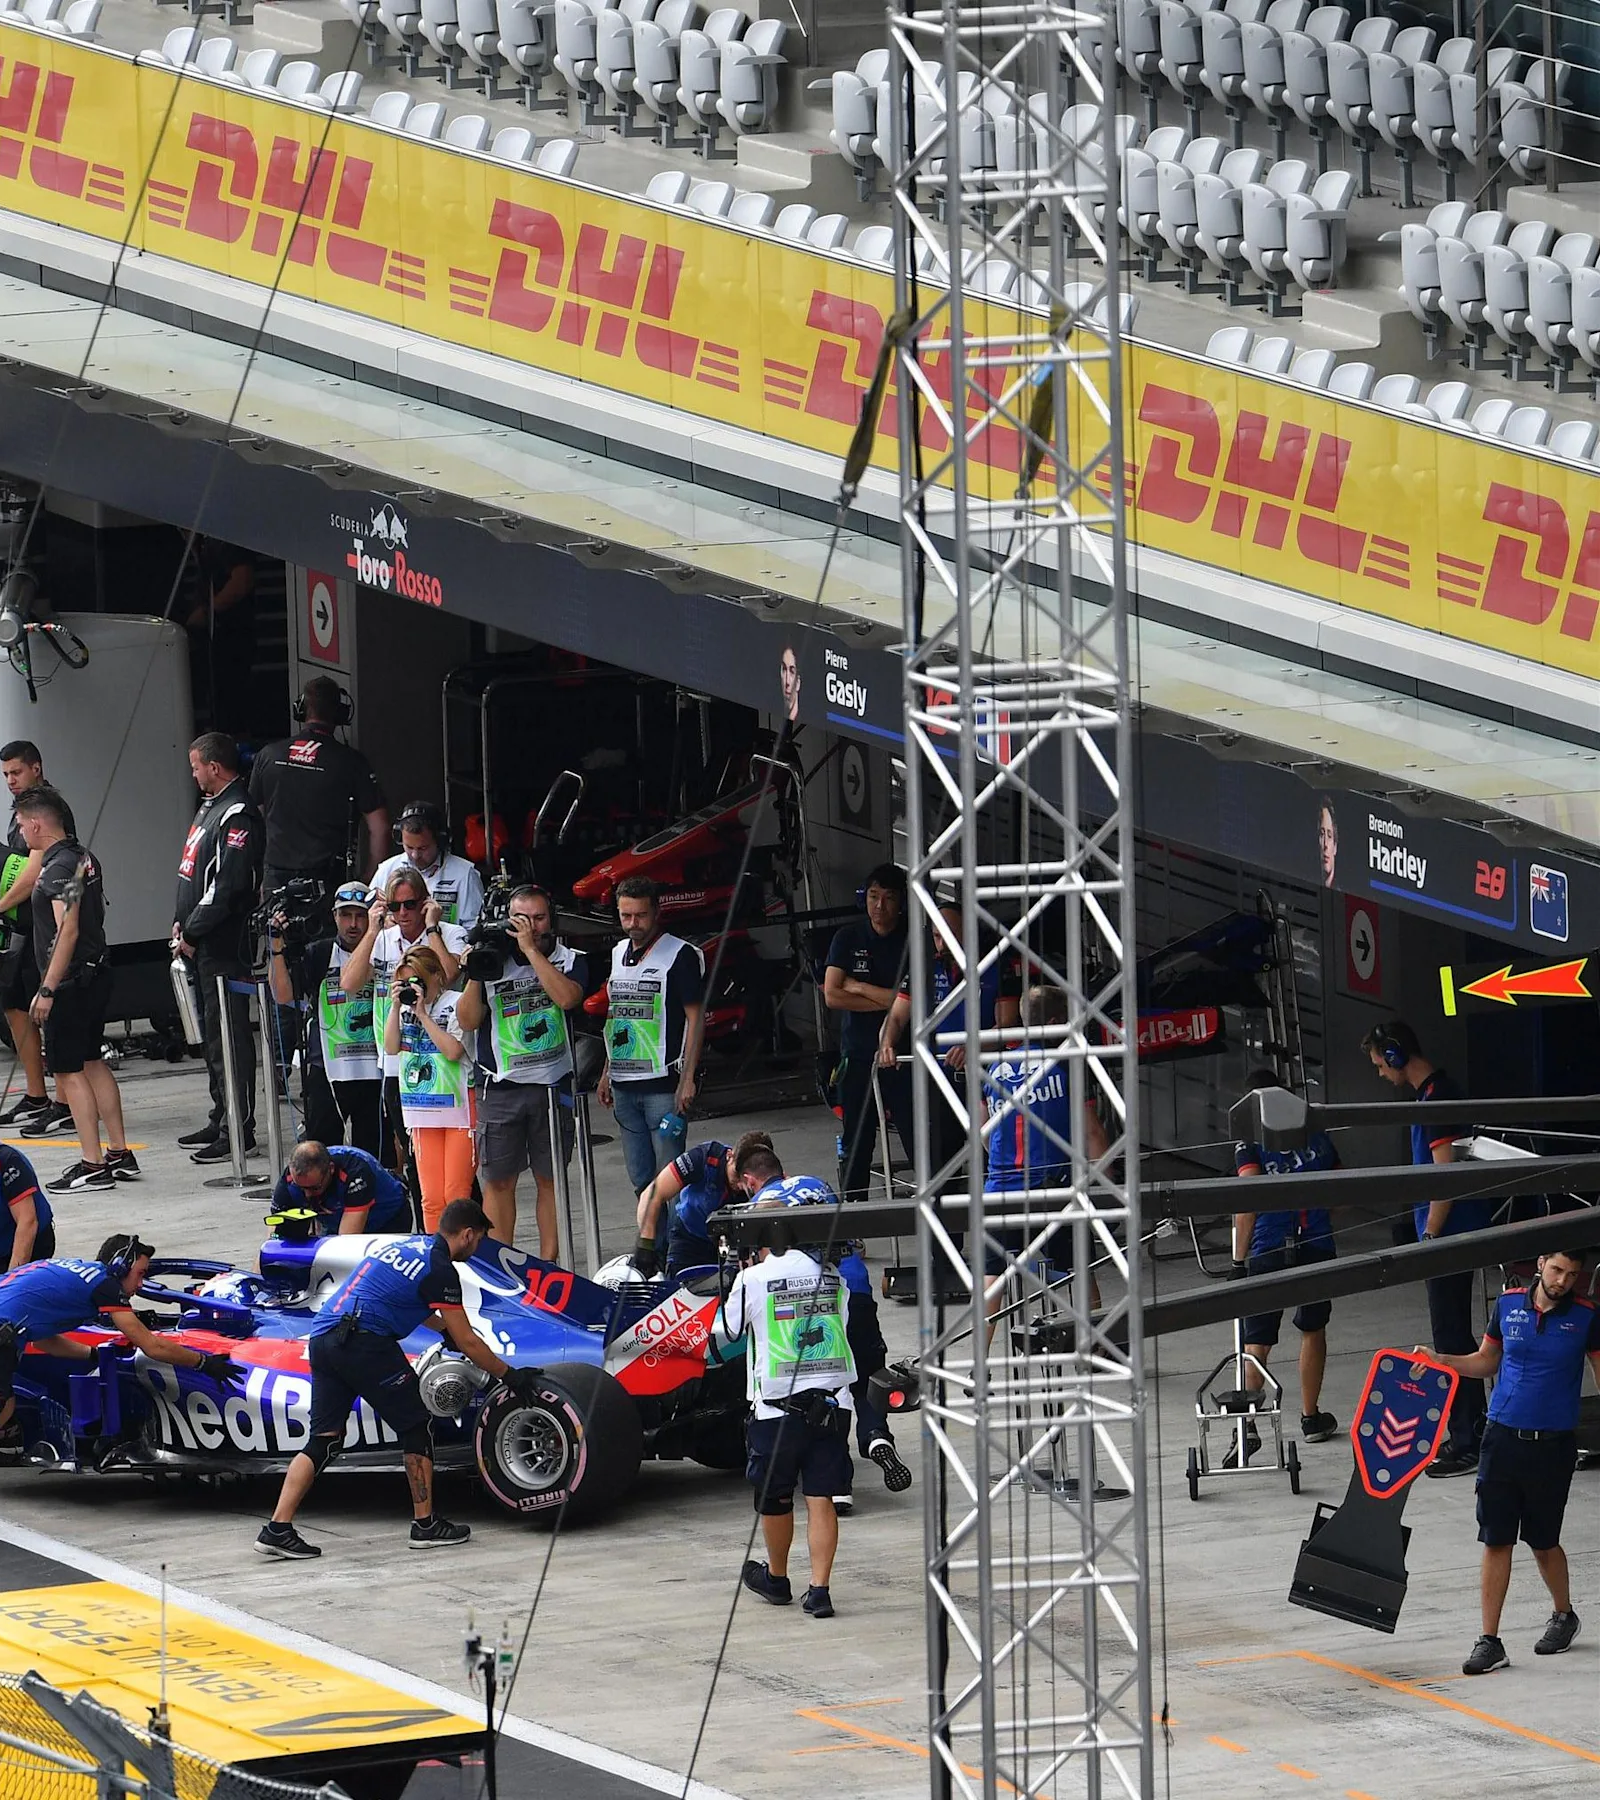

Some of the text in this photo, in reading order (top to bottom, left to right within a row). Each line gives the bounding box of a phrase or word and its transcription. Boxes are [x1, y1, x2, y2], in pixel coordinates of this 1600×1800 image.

[185, 112, 388, 286] DHL
[488, 198, 700, 379] DHL
[1137, 383, 1367, 573] DHL
[330, 513, 369, 537] SCUDERIA
[353, 537, 442, 607] Toro Rosso
[825, 649, 848, 670] Pierre
[825, 672, 867, 717] Gasly
[1368, 813, 1403, 839] Brendon
[1368, 837, 1506, 900] Hartley 28
[616, 1006, 644, 1018] SOCHI
[520, 1268, 574, 1314] 10
[621, 1328, 649, 1354] simply
[635, 1298, 692, 1344] COLA
[643, 1316, 703, 1367] ORGANICS
[94, 1645, 280, 1704] RENAULT
